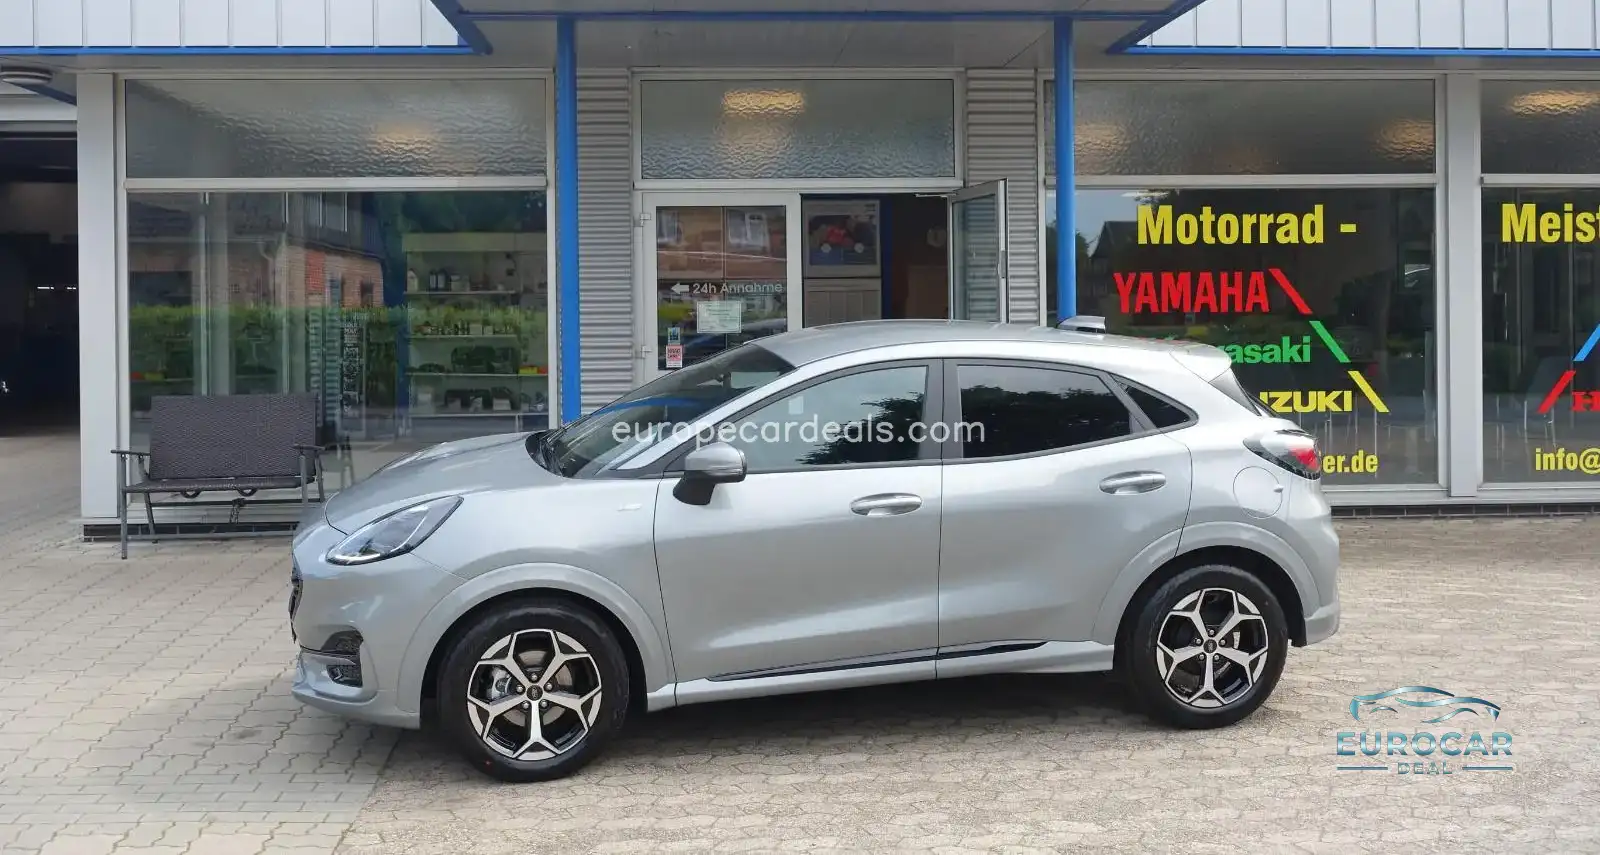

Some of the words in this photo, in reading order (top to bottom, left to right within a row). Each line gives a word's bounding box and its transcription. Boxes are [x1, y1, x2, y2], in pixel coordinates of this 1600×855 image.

[1137, 204, 1324, 245] Motorrad
[1502, 203, 1600, 243] Meis
[692, 282, 717, 294] 24h
[719, 282, 784, 294] Annahme
[1113, 271, 1270, 314] YAMAHA
[1217, 336, 1311, 363] asaki
